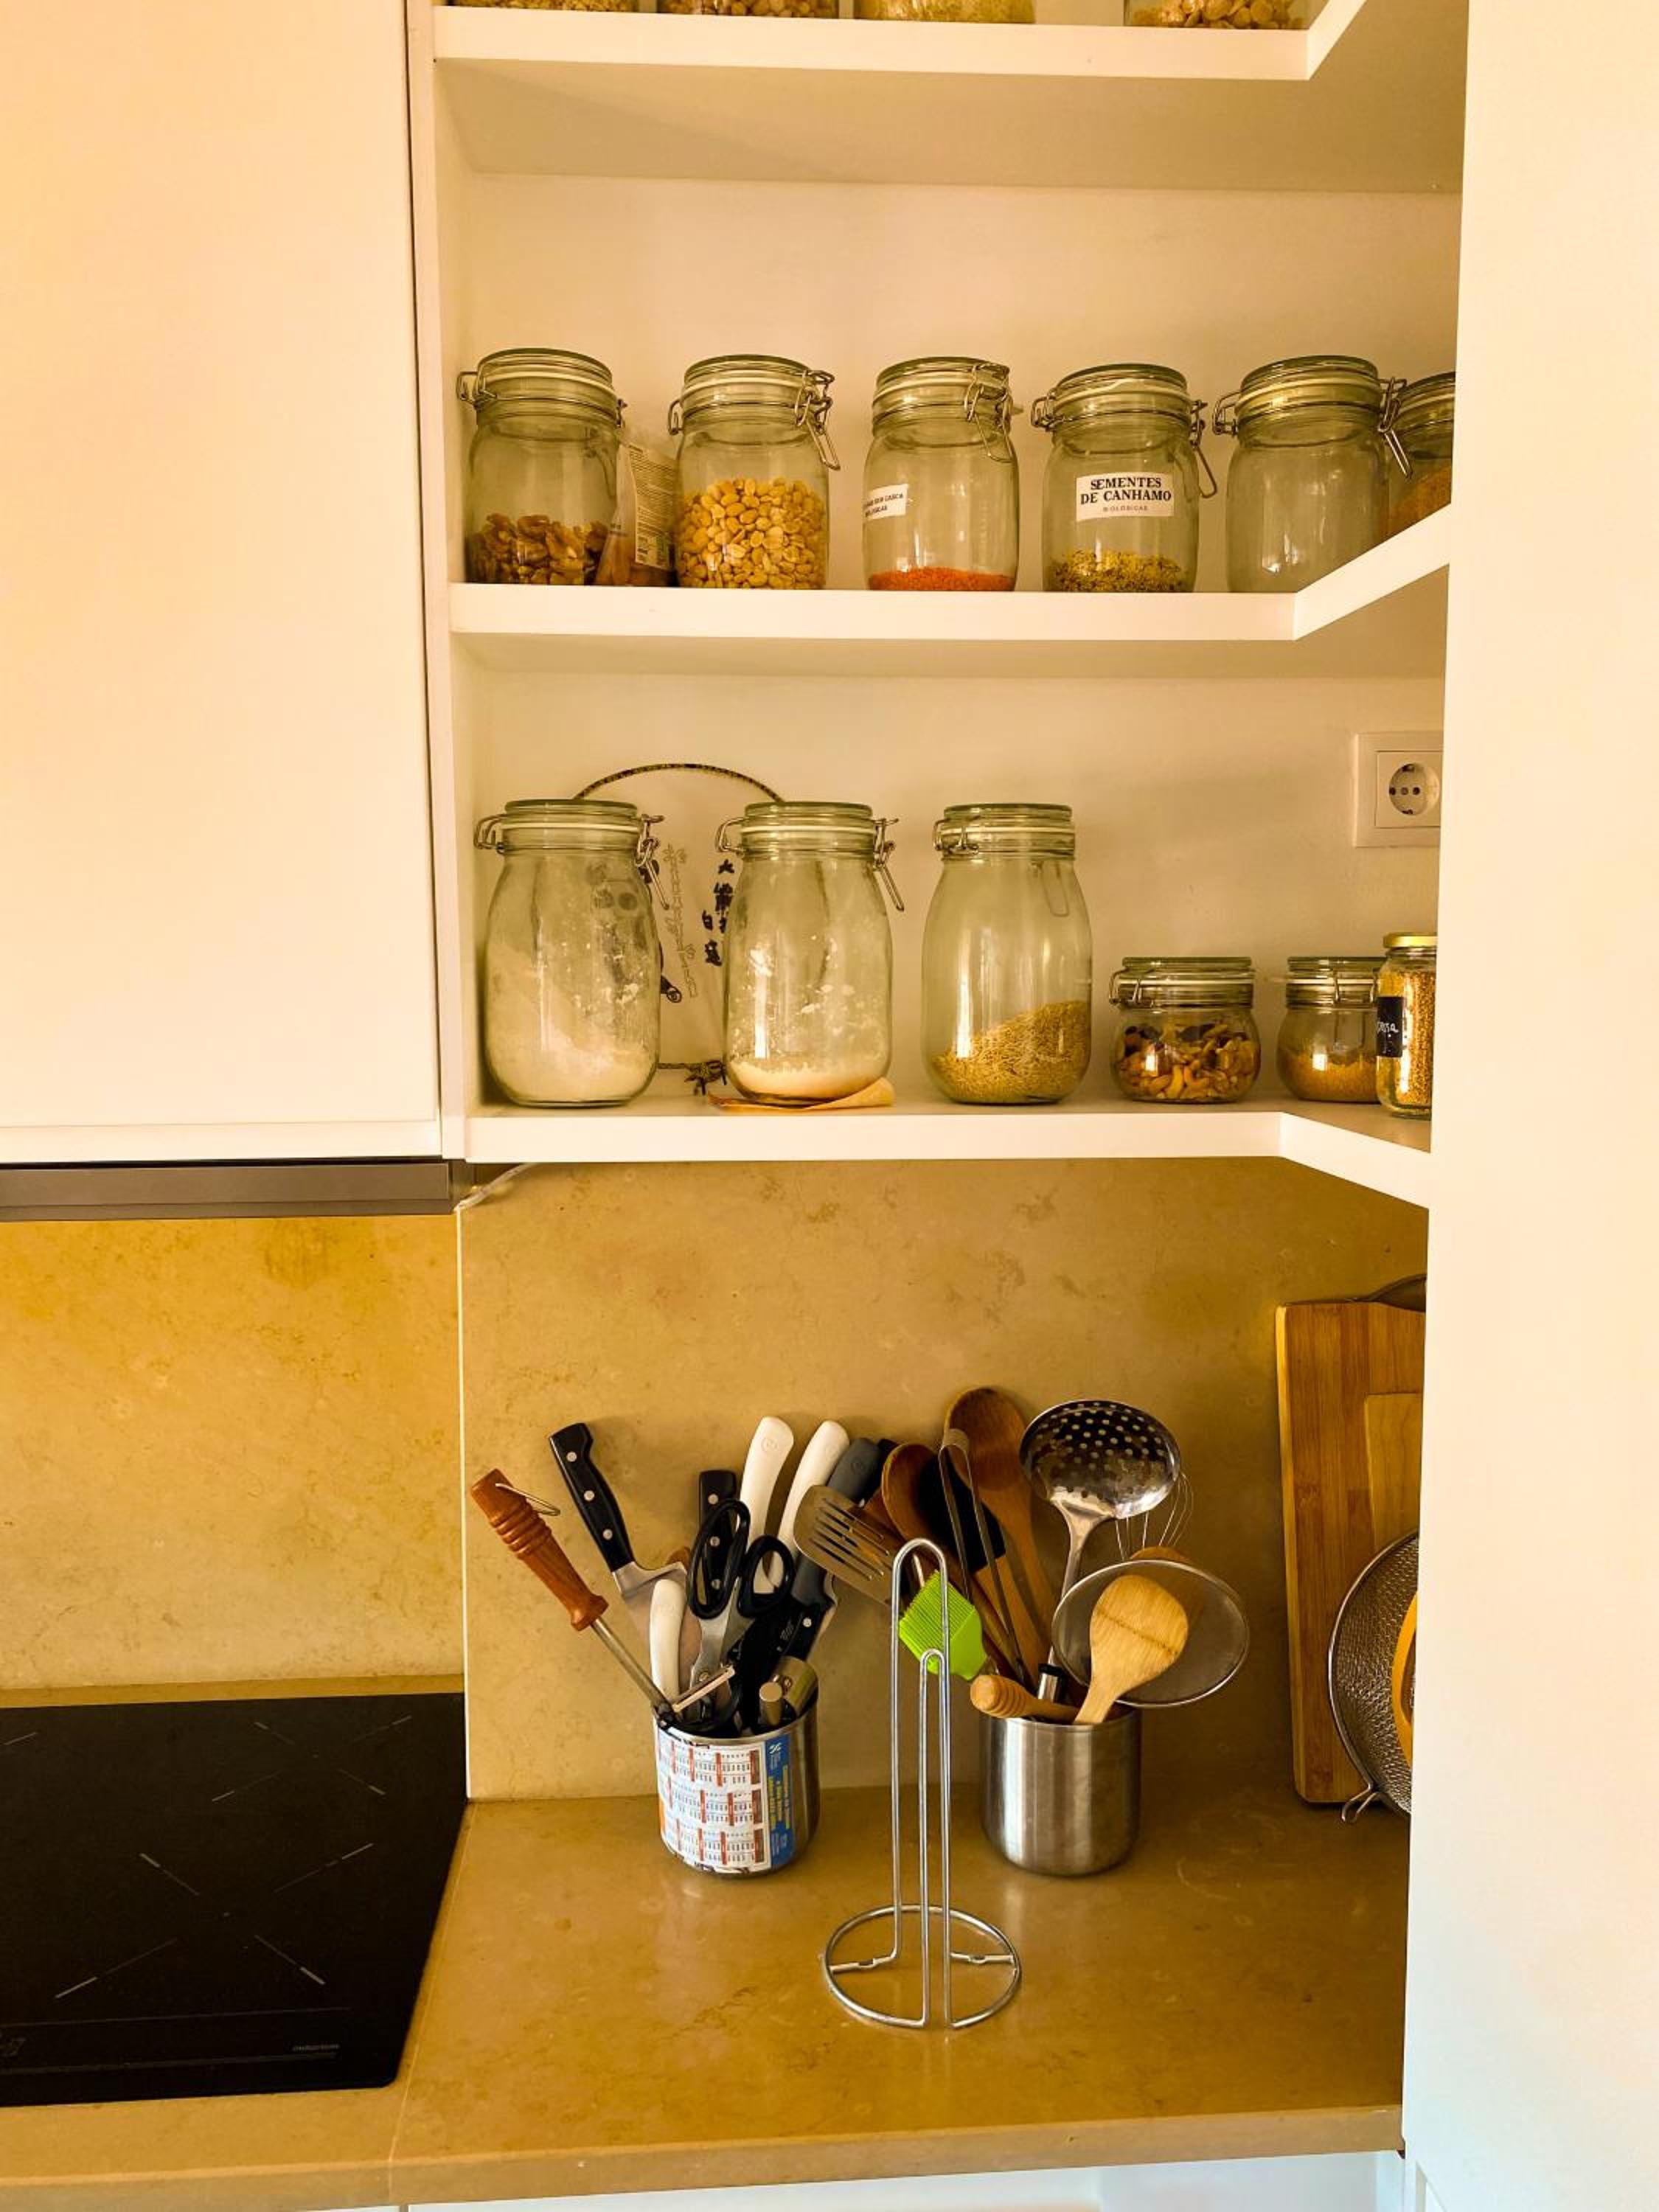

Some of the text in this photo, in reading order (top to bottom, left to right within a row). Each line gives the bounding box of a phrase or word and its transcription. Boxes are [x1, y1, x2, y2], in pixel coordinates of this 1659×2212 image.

[1091, 477, 1162, 490] SEMENTES
[1080, 489, 1172, 505] DE CANHAMO
